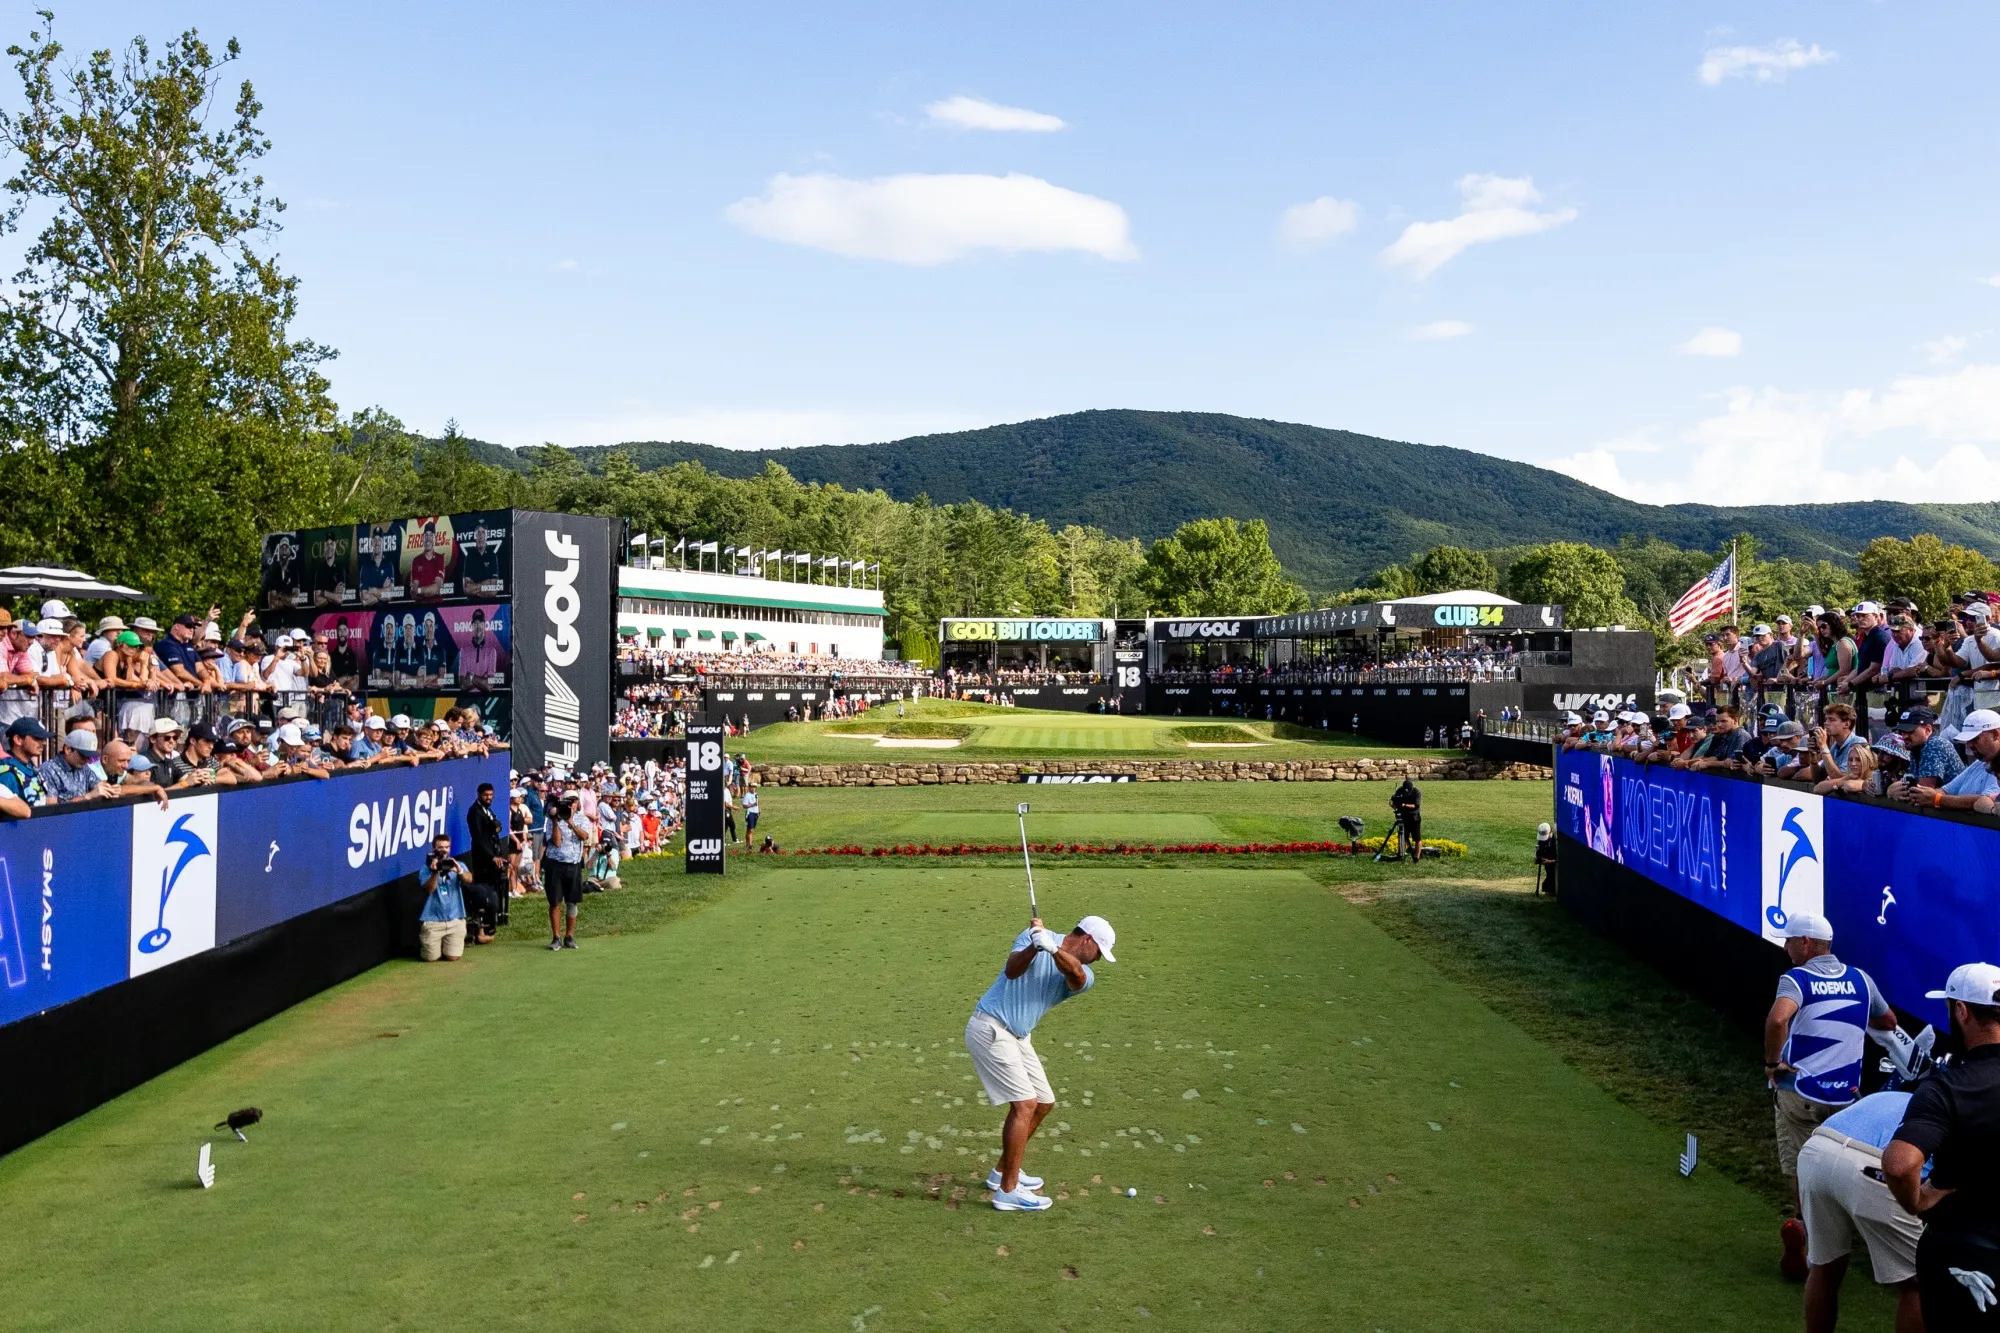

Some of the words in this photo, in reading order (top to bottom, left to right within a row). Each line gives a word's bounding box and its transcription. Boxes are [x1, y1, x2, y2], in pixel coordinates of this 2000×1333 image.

[998, 622, 1029, 640] BUT
[1031, 622, 1094, 640] LOUDER
[1117, 666, 1141, 688] 18
[687, 741, 722, 771] 18
[347, 786, 447, 869] SMASH
[1622, 776, 1717, 889] KOEPKA
[688, 839, 722, 855] CW
[41, 847, 53, 971] SMASH
[1810, 980, 1857, 995] KOEPKA
